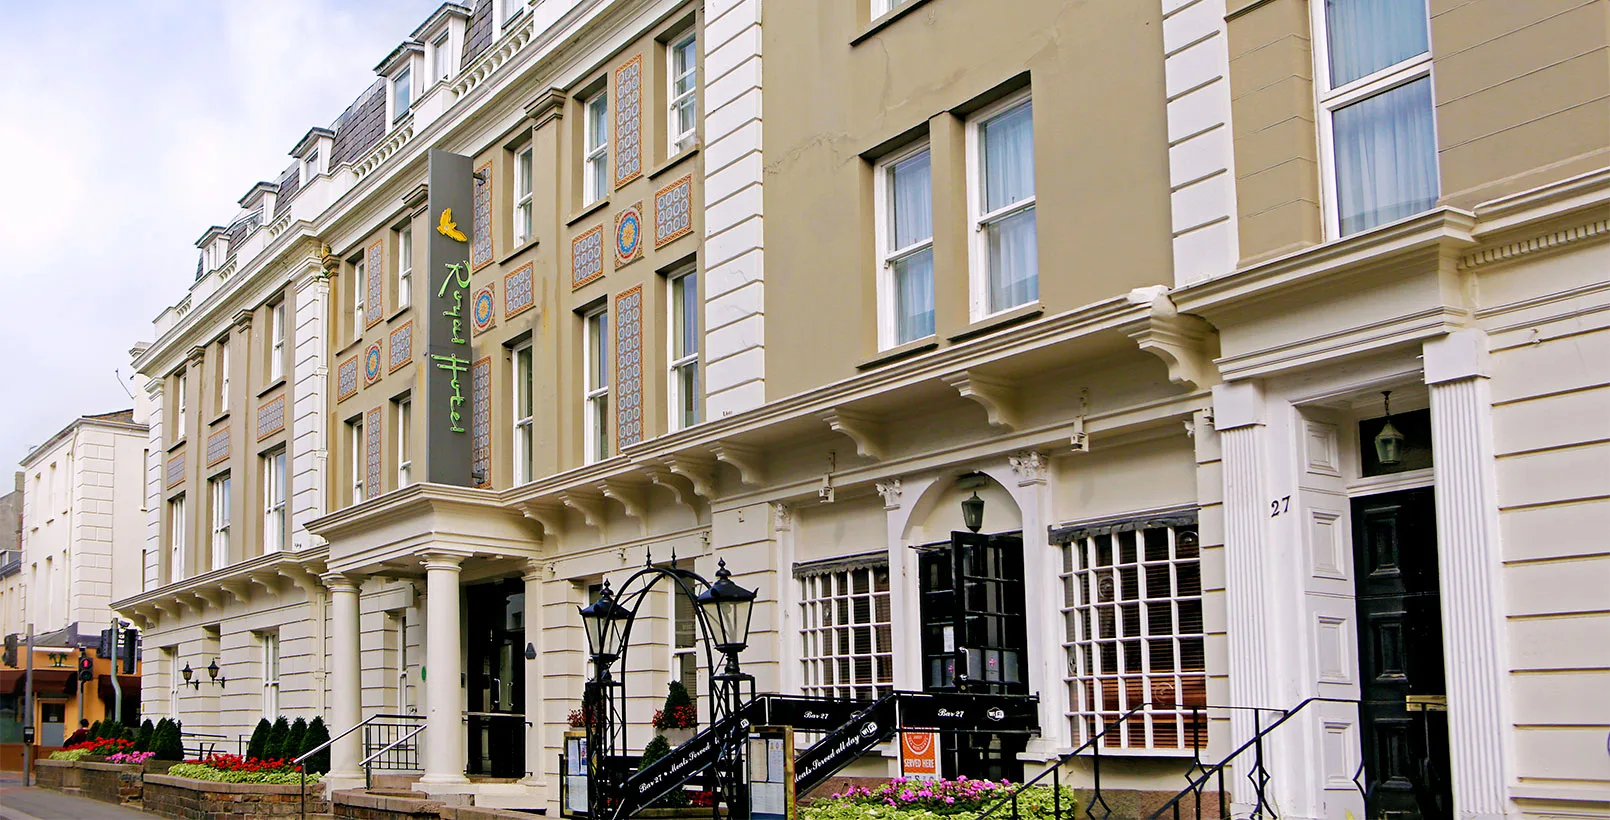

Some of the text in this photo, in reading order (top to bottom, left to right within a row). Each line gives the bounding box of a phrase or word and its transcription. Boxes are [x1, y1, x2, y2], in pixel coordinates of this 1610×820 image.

[430, 260, 471, 433] Royal Hotel
[1271, 495, 1291, 518] 27
[803, 710, 820, 719] Bar
[937, 708, 965, 718] Bar 27
[812, 748, 835, 771] Served
[835, 741, 846, 755] all
[845, 735, 861, 746] day
[904, 758, 935, 769] SERVED HERE
[639, 742, 711, 793] Bar 27 Meals Served
